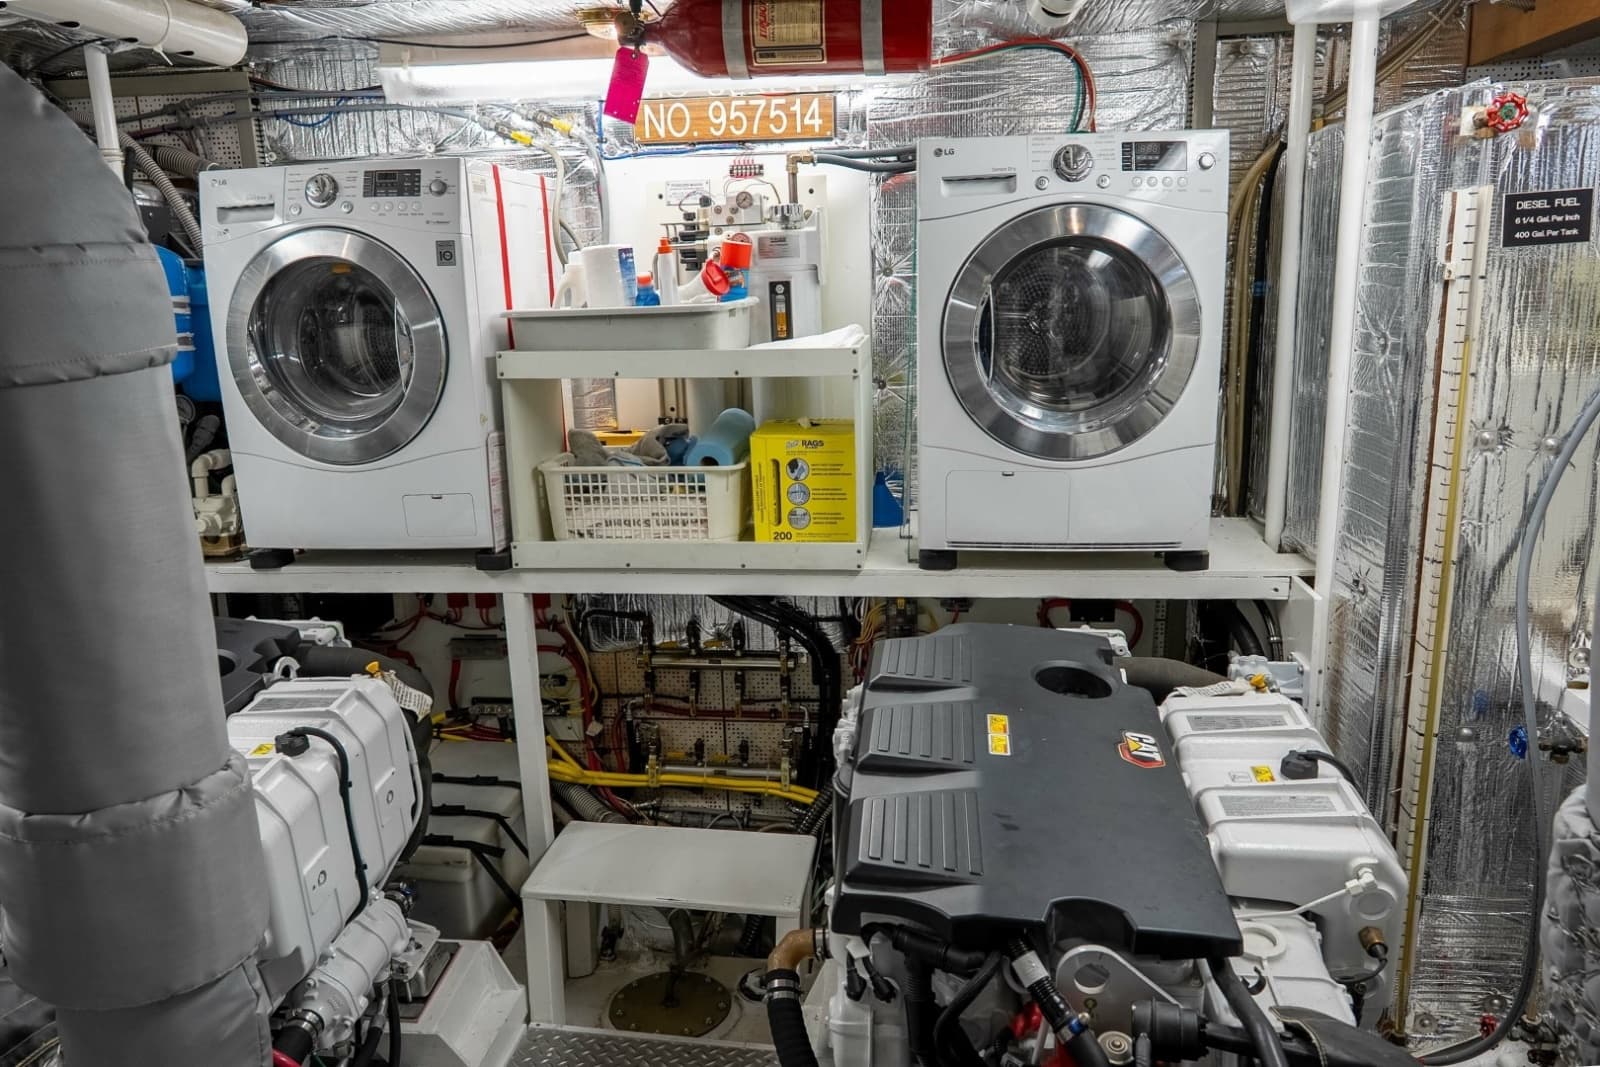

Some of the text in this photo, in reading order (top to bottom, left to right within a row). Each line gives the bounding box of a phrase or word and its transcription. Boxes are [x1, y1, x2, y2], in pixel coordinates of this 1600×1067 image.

[643, 97, 823, 138] NO. 957514
[944, 148, 955, 156] LG
[1516, 197, 1581, 211] DIESEL FUEL
[1515, 217, 1521, 225] 6
[1522, 216, 1535, 224] 1/4
[1565, 214, 1581, 222] Inch
[1514, 231, 1530, 239] 400
[1547, 229, 1560, 237] Per
[1561, 228, 1579, 236] Tank
[801, 439, 824, 447] RAGS
[773, 531, 793, 541] 200
[1125, 731, 1162, 762] CAT
